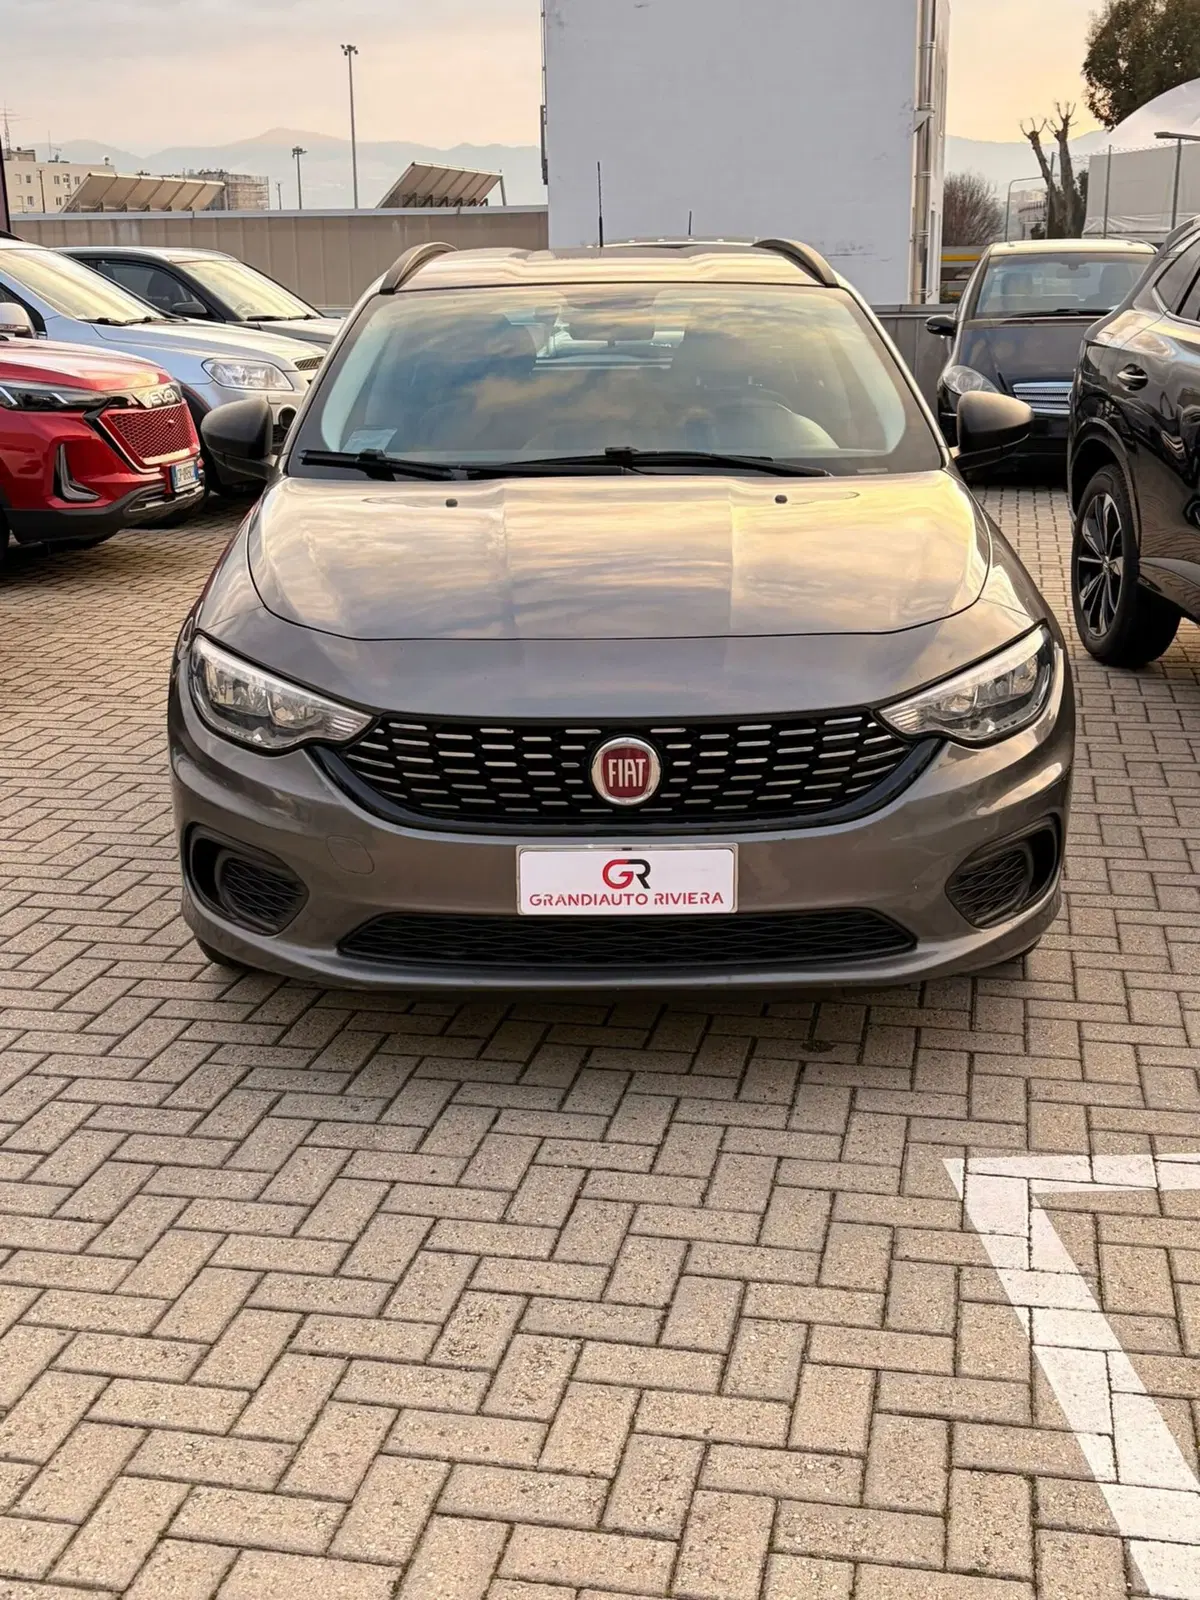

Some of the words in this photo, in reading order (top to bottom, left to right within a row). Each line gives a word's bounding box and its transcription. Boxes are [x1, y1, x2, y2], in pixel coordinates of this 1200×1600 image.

[608, 758, 646, 787] FIAT
[602, 858, 651, 889] GR
[529, 892, 648, 907] GRANDIAUTO
[654, 891, 724, 906] RIVIERA
